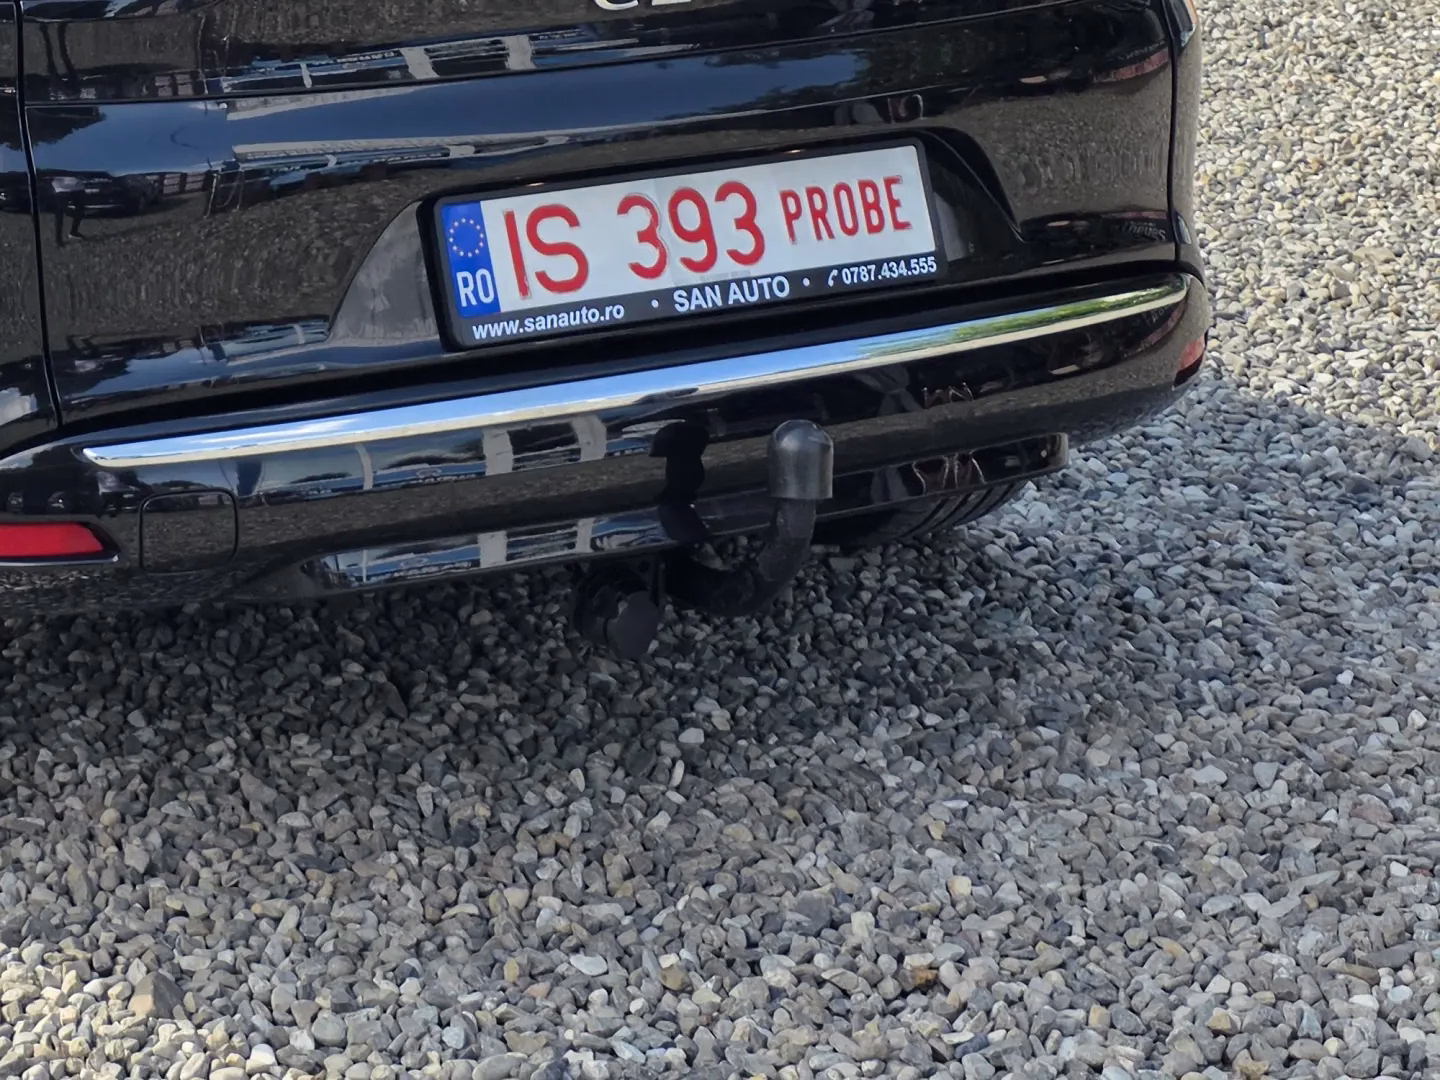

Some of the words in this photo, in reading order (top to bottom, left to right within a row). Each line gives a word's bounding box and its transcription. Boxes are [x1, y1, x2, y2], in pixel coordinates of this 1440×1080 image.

[503, 203, 590, 300] IS
[616, 179, 767, 280] 393
[778, 174, 913, 246] PROBE
[456, 267, 496, 309] RO
[471, 302, 626, 342] www.sanauto.ro
[672, 283, 724, 314] SAN
[727, 274, 792, 306] AUTO
[840, 255, 938, 286] 0787.434.555
